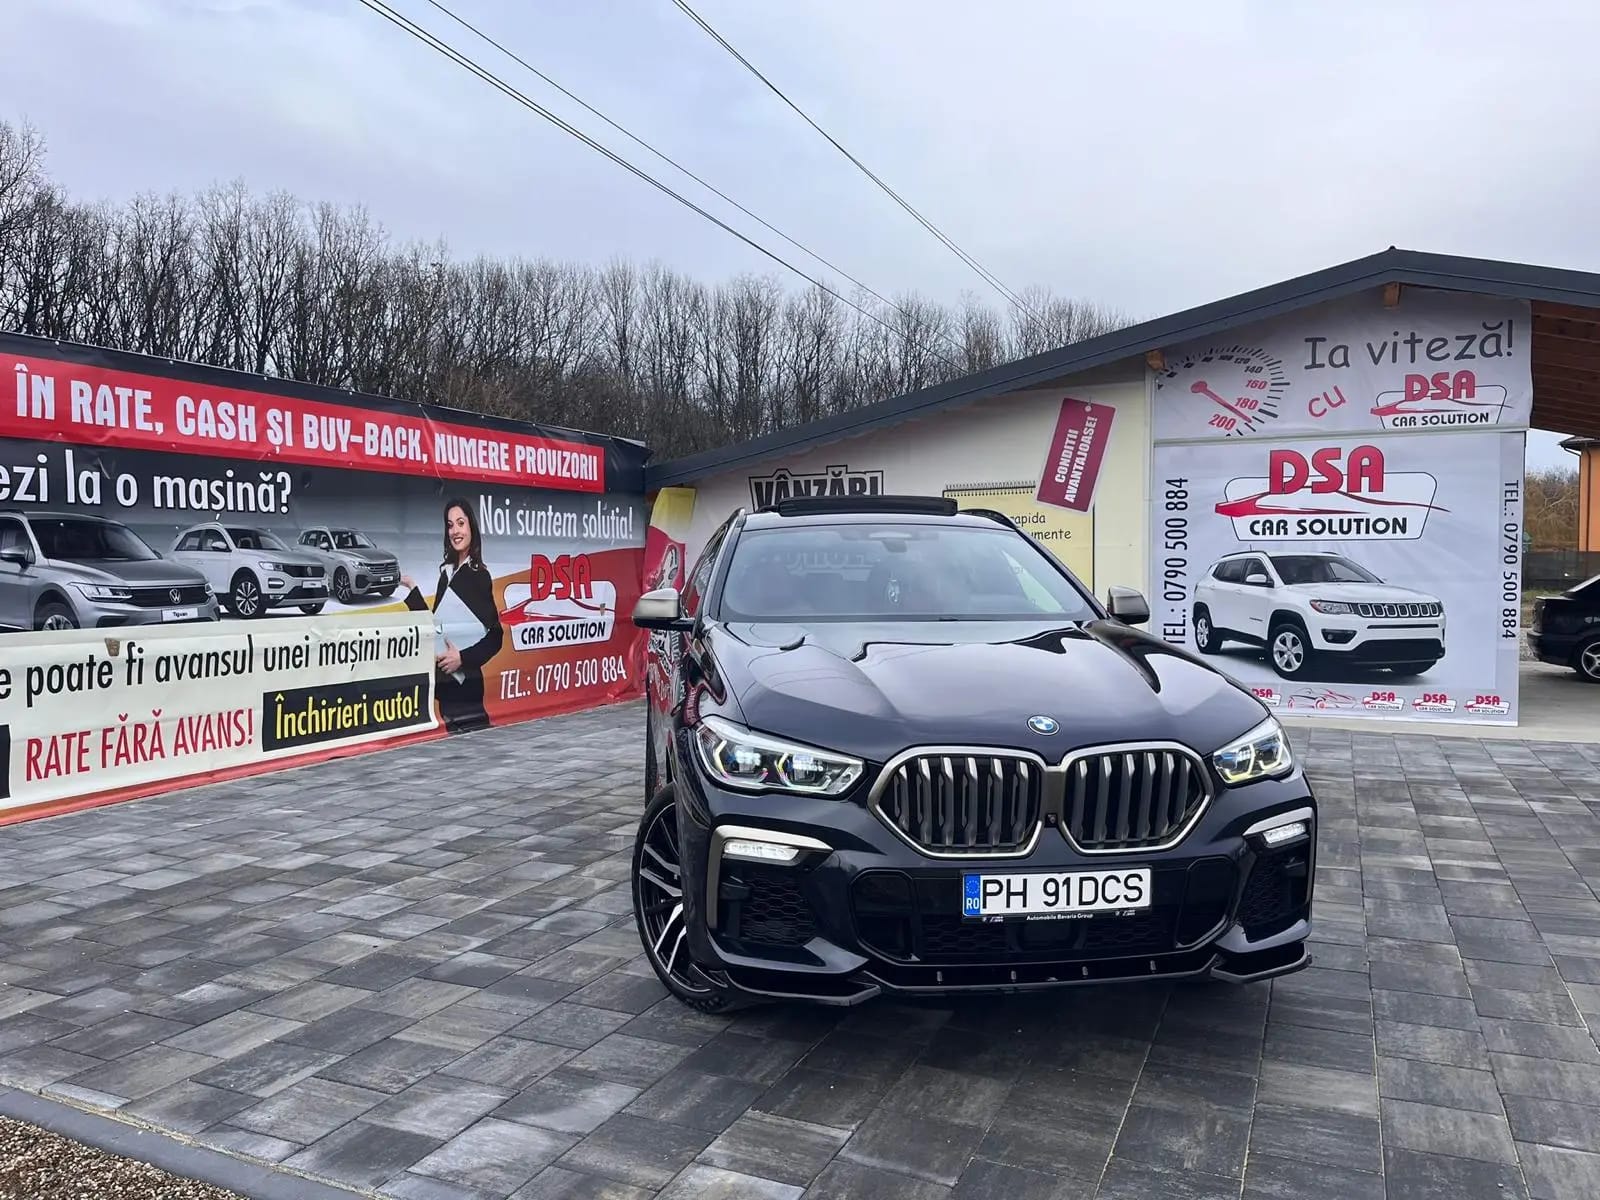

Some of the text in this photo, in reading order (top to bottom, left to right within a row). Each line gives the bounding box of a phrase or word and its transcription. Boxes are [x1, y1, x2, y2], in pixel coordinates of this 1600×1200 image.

[1304, 320, 1514, 370] Ia viteză!
[1245, 380, 1267, 389] 160
[1404, 370, 1476, 400] DSA
[1235, 397, 1259, 410] 180
[1308, 385, 1346, 418] cu
[14, 363, 598, 481] ÎN RATE, CASH ȘI BUY-BACK, NUMERE PROVIZORII
[1208, 414, 1236, 430] 200
[1392, 412, 1489, 428] CAR SOLUTION
[1064, 416, 1098, 503] AVANTAJOASE!
[1269, 445, 1385, 494] DSA
[65, 449, 101, 504] la
[116, 473, 138, 506] o
[153, 469, 292, 520] mașină?
[1165, 478, 1188, 511] 884
[480, 494, 633, 546] Noi suntem soluția!
[1031, 529, 1072, 540] mente
[1165, 518, 1188, 551] 500
[1249, 516, 1407, 536] CAR SOLUTION
[1502, 480, 1519, 639] TEL.: 0790 500 884
[530, 554, 593, 600] DSA
[1164, 558, 1187, 602] 0790
[521, 621, 606, 645] CAR SOLUTION
[27, 654, 113, 707] poate
[126, 641, 144, 686] fi
[154, 634, 254, 684] avansul
[263, 635, 310, 672] unei
[319, 630, 380, 673] mașini
[387, 626, 421, 659] noi!
[500, 655, 627, 700] TEL.: 0790 500 884
[276, 685, 420, 741] Închirieri auto!
[1372, 692, 1395, 701] DSA
[1423, 693, 1447, 704] DSA
[1475, 696, 1500, 705] DSA
[26, 708, 254, 782] RATE FĂRĂ AVANS!
[966, 897, 980, 910] RO
[982, 878, 1028, 909] PH
